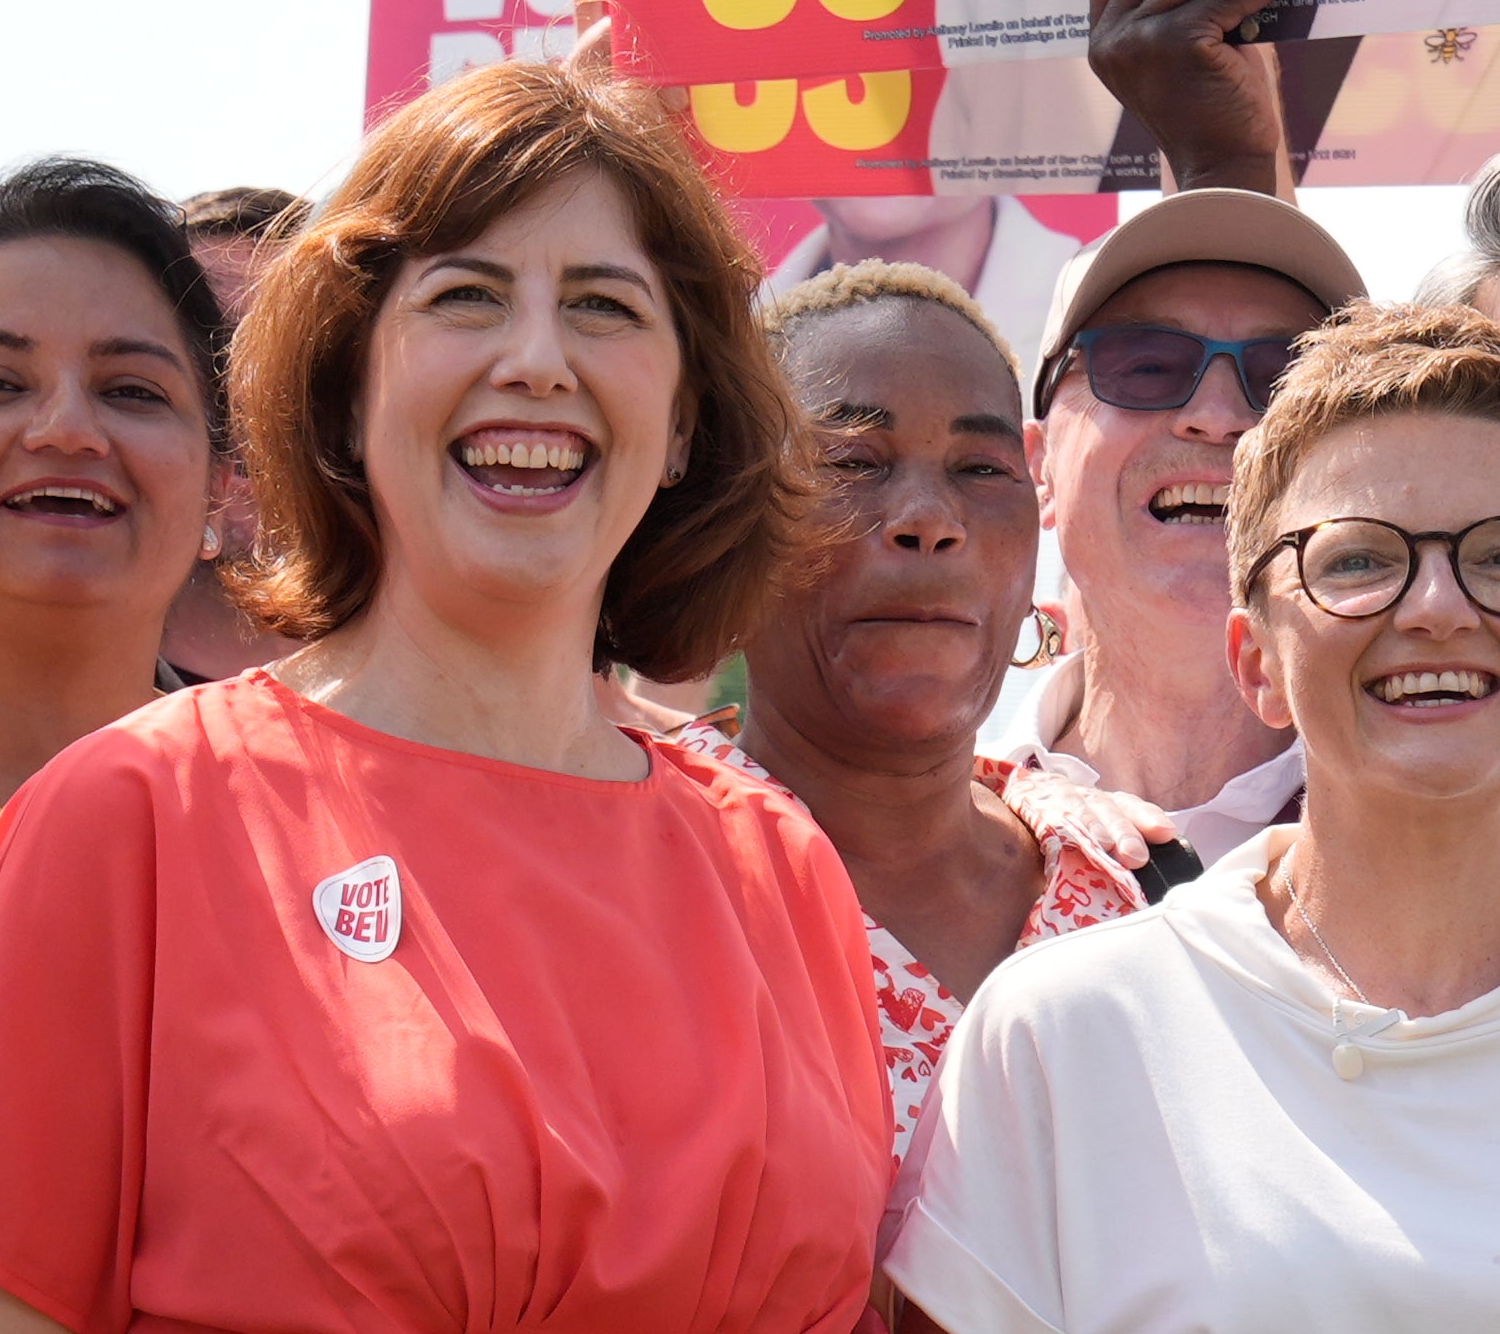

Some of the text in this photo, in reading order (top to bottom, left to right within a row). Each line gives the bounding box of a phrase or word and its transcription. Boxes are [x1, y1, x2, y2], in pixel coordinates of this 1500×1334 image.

[863, 28, 910, 41] Promoted
[913, 28, 925, 40] by
[926, 25, 967, 35] Anthony
[1006, 21, 1019, 30] on
[1021, 16, 1052, 28] behalf
[1053, 15, 1064, 26] of
[1065, 14, 1085, 25] Bev
[948, 35, 984, 48] Printed
[985, 34, 998, 47] by
[1056, 29, 1067, 39] at
[341, 874, 389, 908] VOTE
[334, 907, 388, 943] BEV
